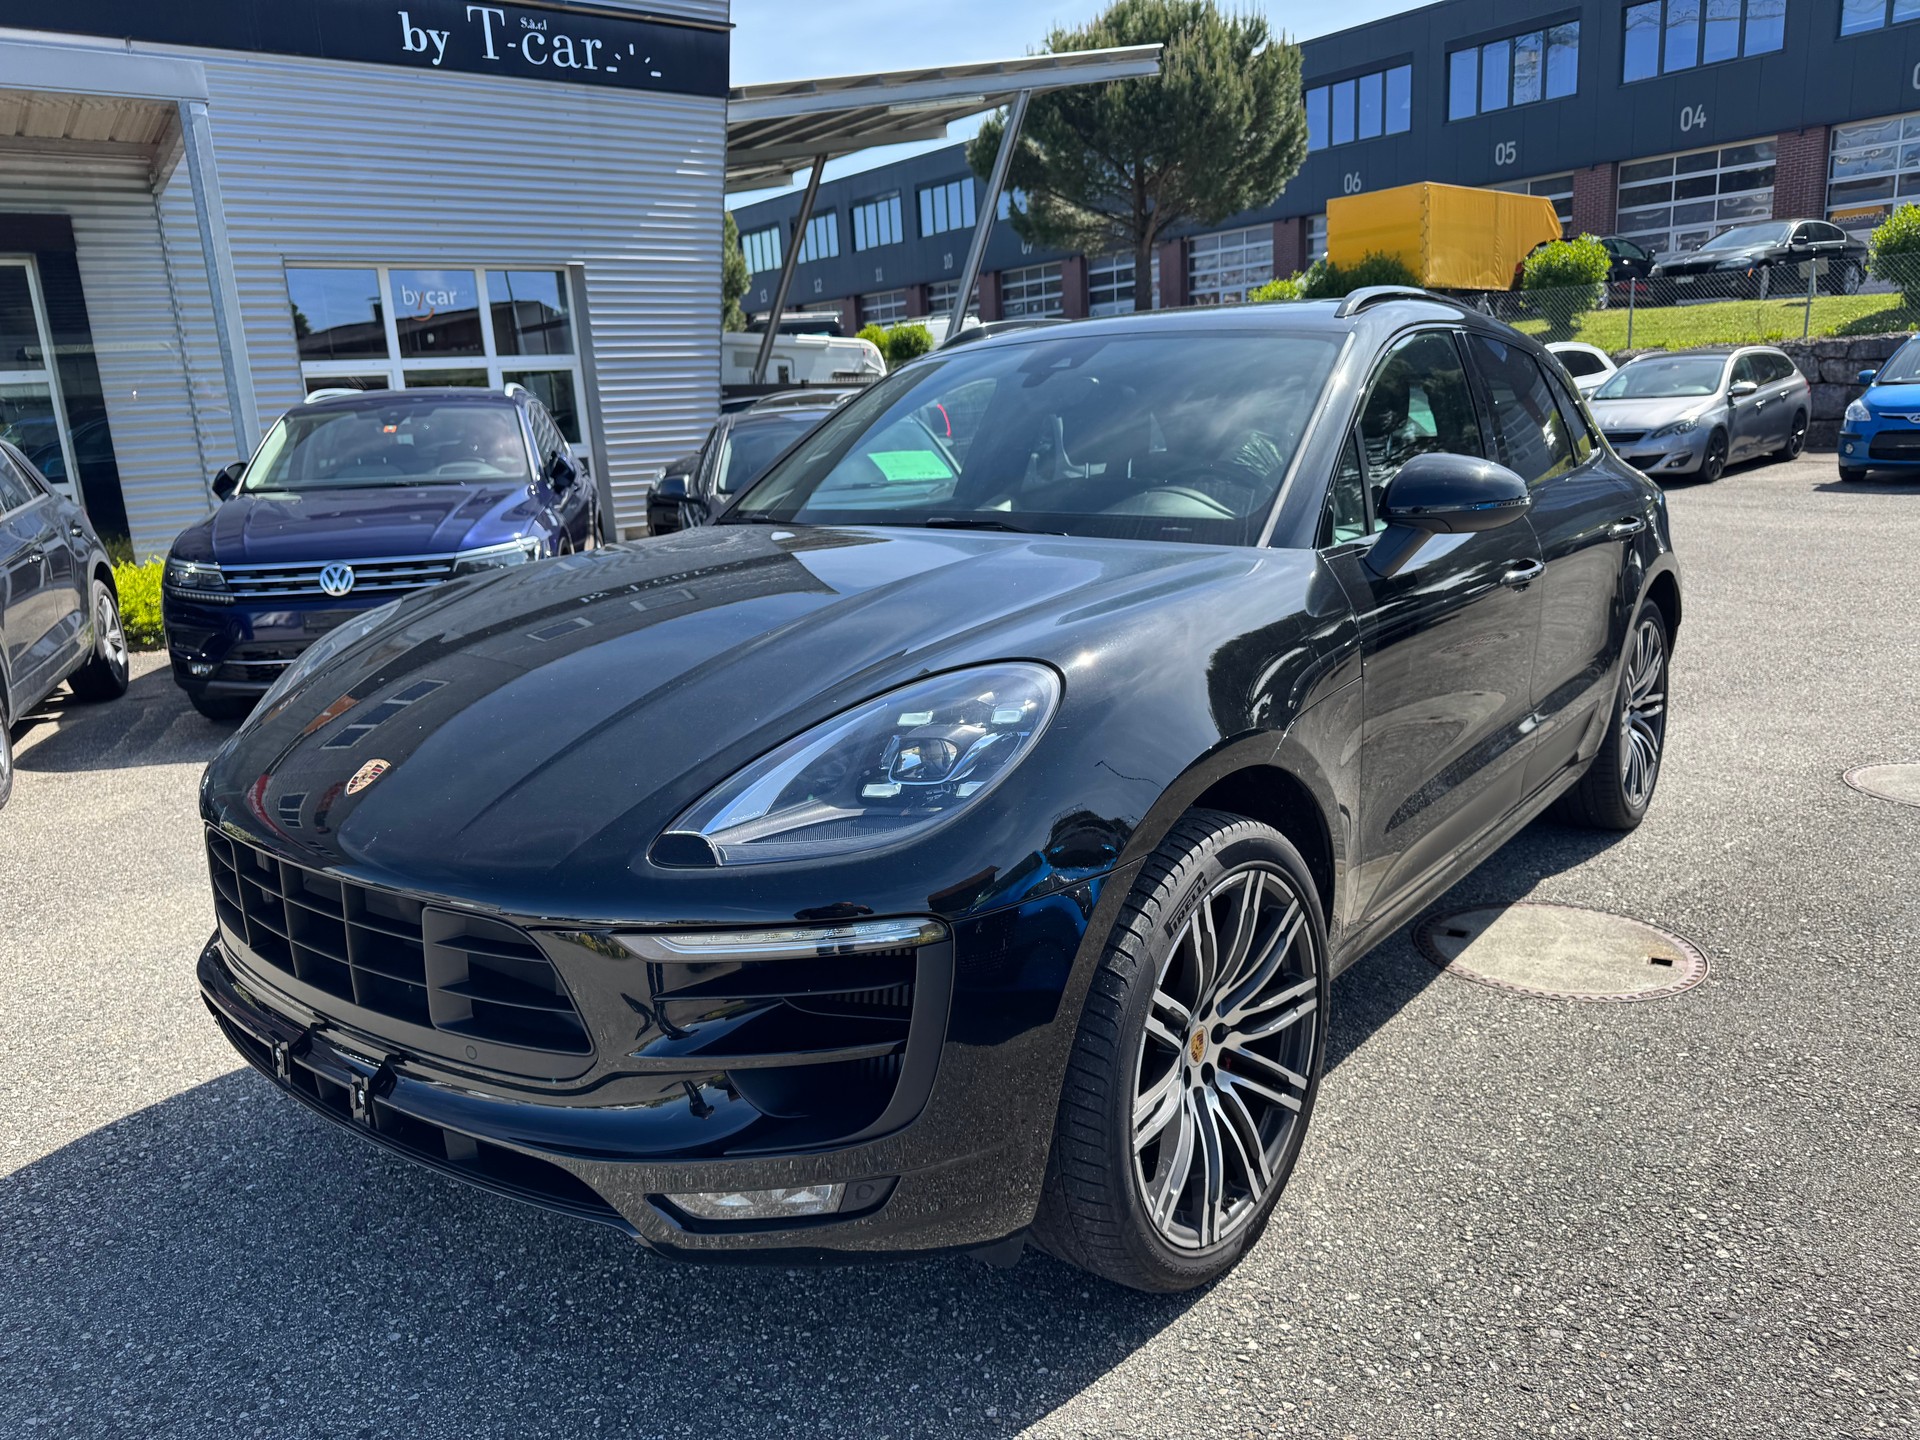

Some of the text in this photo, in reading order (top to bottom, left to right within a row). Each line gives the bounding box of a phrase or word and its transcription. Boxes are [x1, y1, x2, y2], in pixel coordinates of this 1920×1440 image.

[398, 11, 450, 66] by
[1680, 104, 1707, 132] 04
[1495, 141, 1516, 166] 05
[1343, 171, 1362, 194] 06
[944, 252, 954, 270] 10
[814, 277, 823, 293] 12
[875, 267, 884, 282] 11
[1163, 871, 1208, 940] PIRELLI
